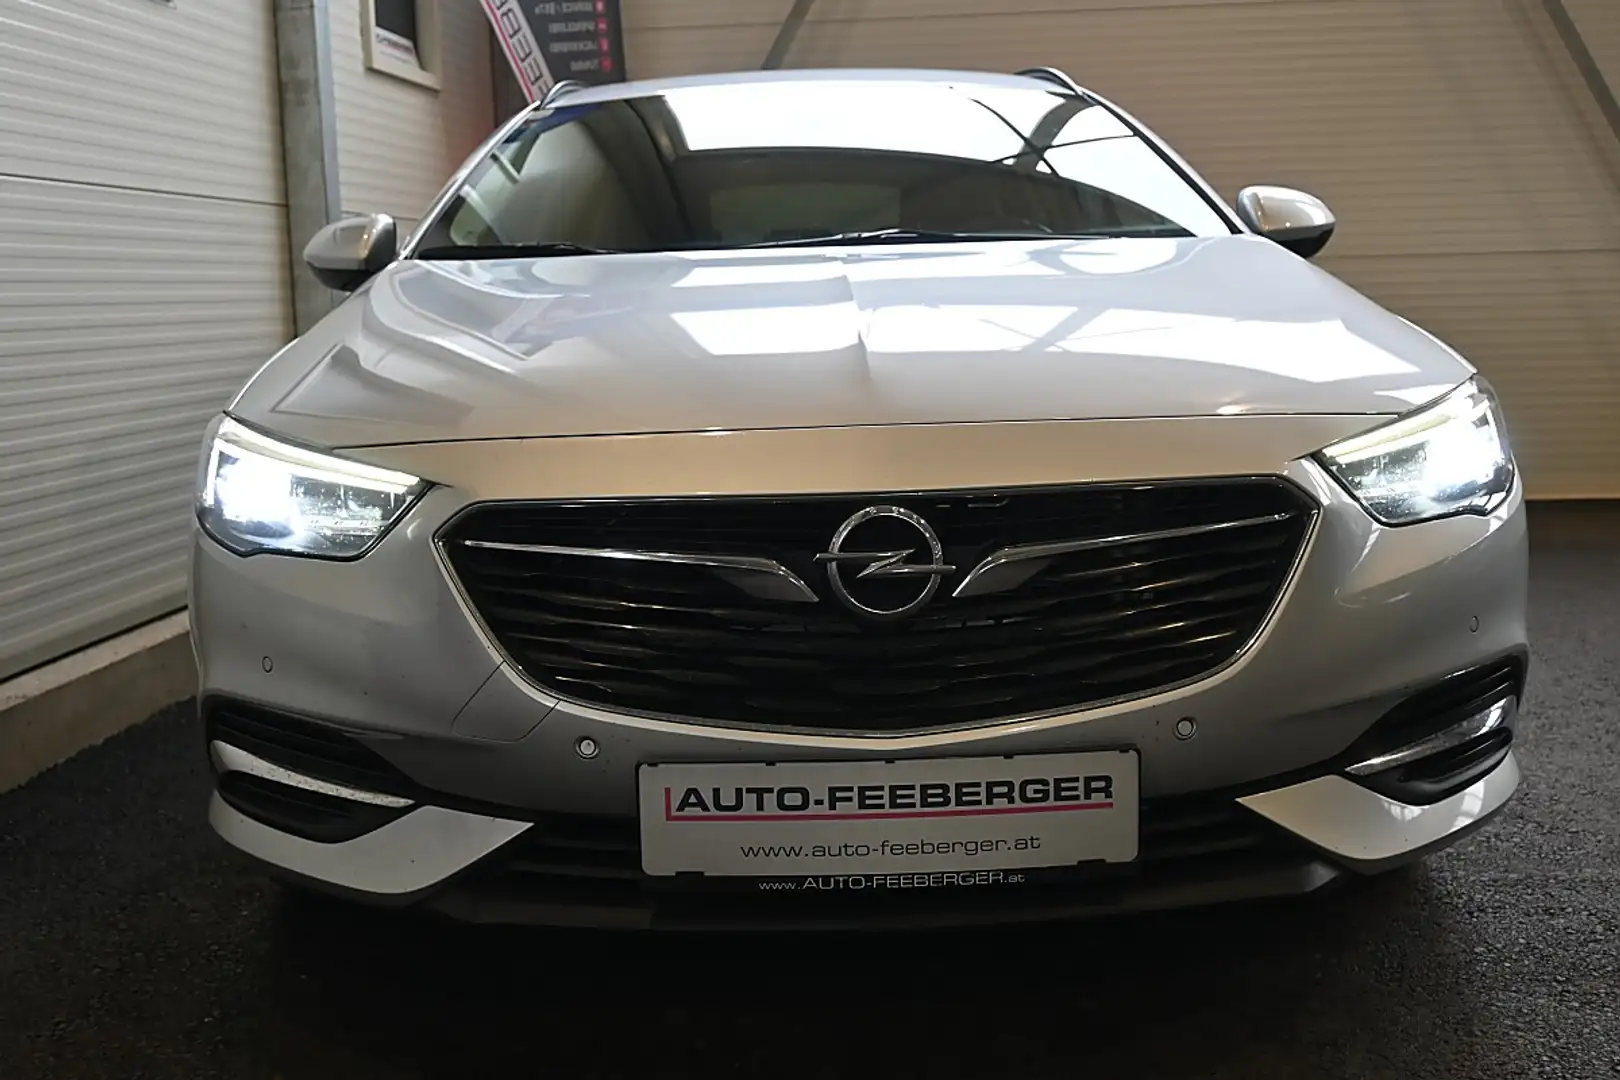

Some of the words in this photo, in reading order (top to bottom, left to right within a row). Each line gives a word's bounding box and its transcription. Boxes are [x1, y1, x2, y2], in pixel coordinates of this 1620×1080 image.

[675, 774, 1114, 813] AUTO-FEEBERGER
[740, 835, 1042, 859] www.auto-feeberger.at
[758, 872, 1026, 891] www.AUTO-FEEBERGER.at
